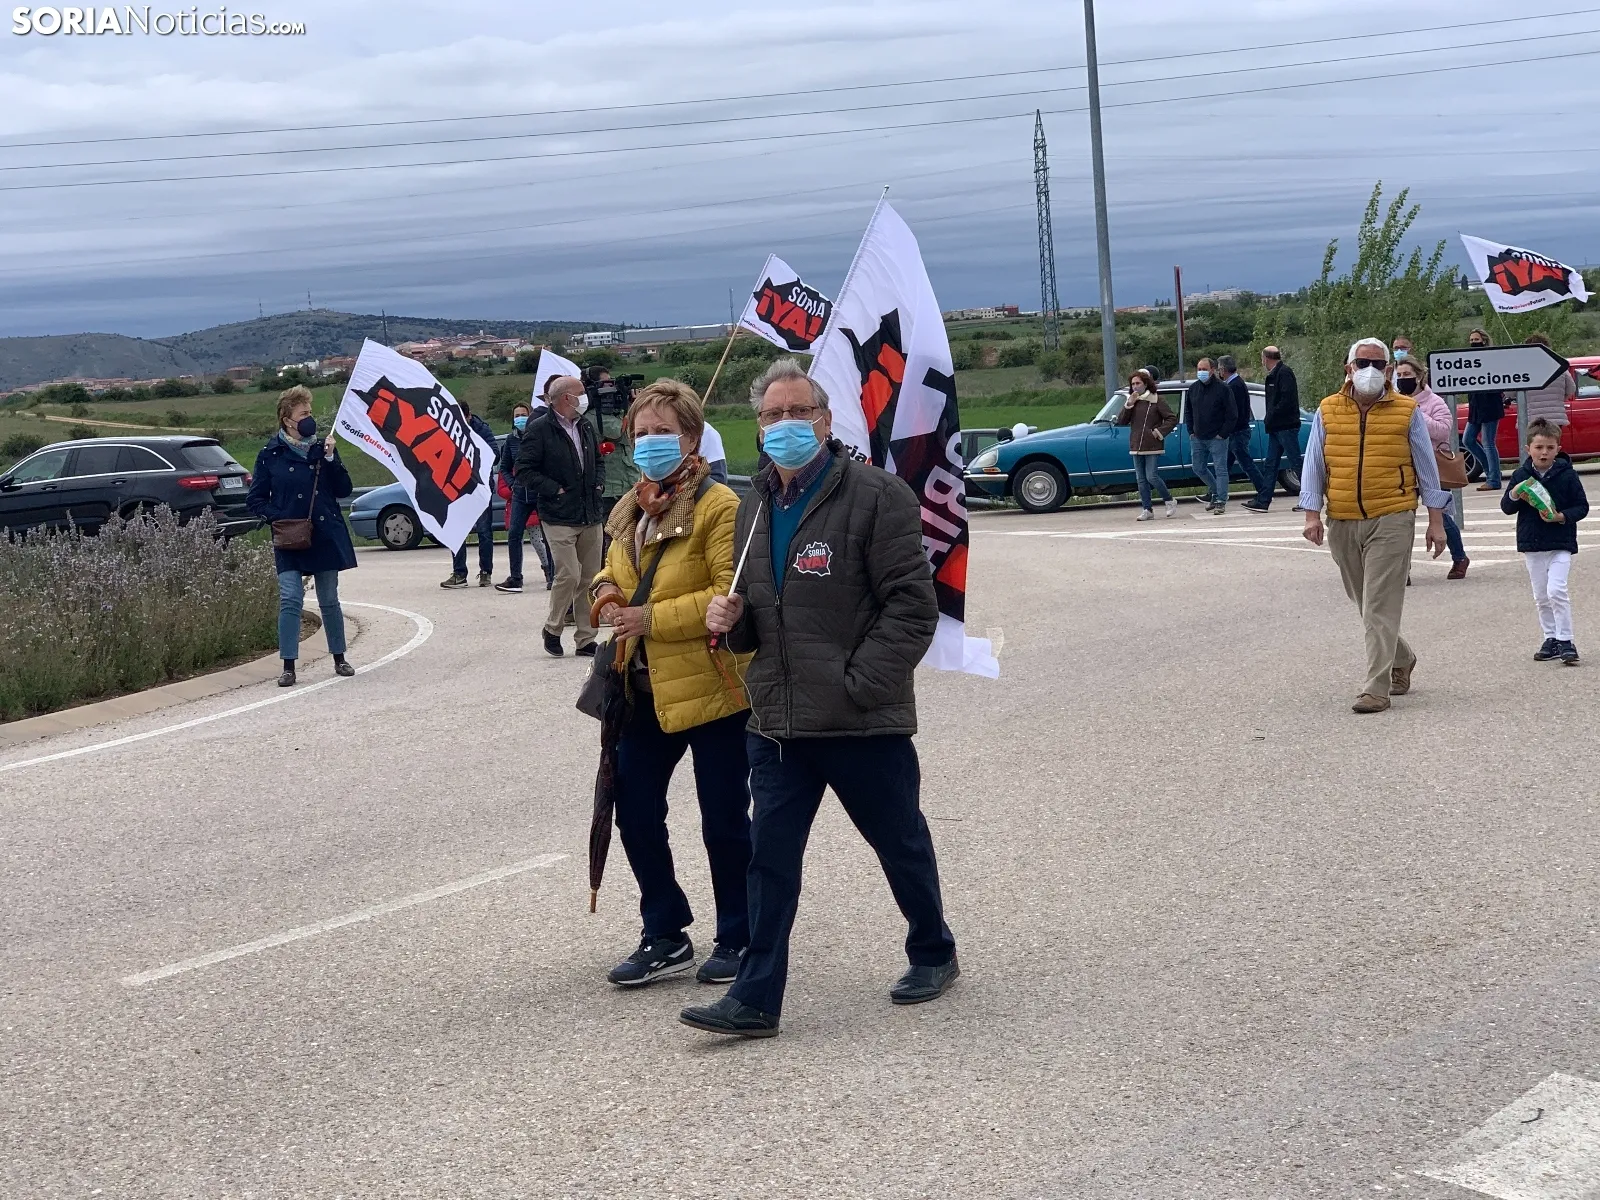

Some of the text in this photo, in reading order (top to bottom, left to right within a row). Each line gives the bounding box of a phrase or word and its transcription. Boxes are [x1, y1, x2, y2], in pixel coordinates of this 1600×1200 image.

[756, 288, 823, 342] ¡YA!
[788, 286, 826, 318] SORIA
[1436, 357, 1482, 370] todas
[1437, 372, 1531, 388] direcciones
[367, 388, 473, 502] ¡YA!
[426, 396, 475, 468] SORIA
[808, 548, 827, 558] SORIA
